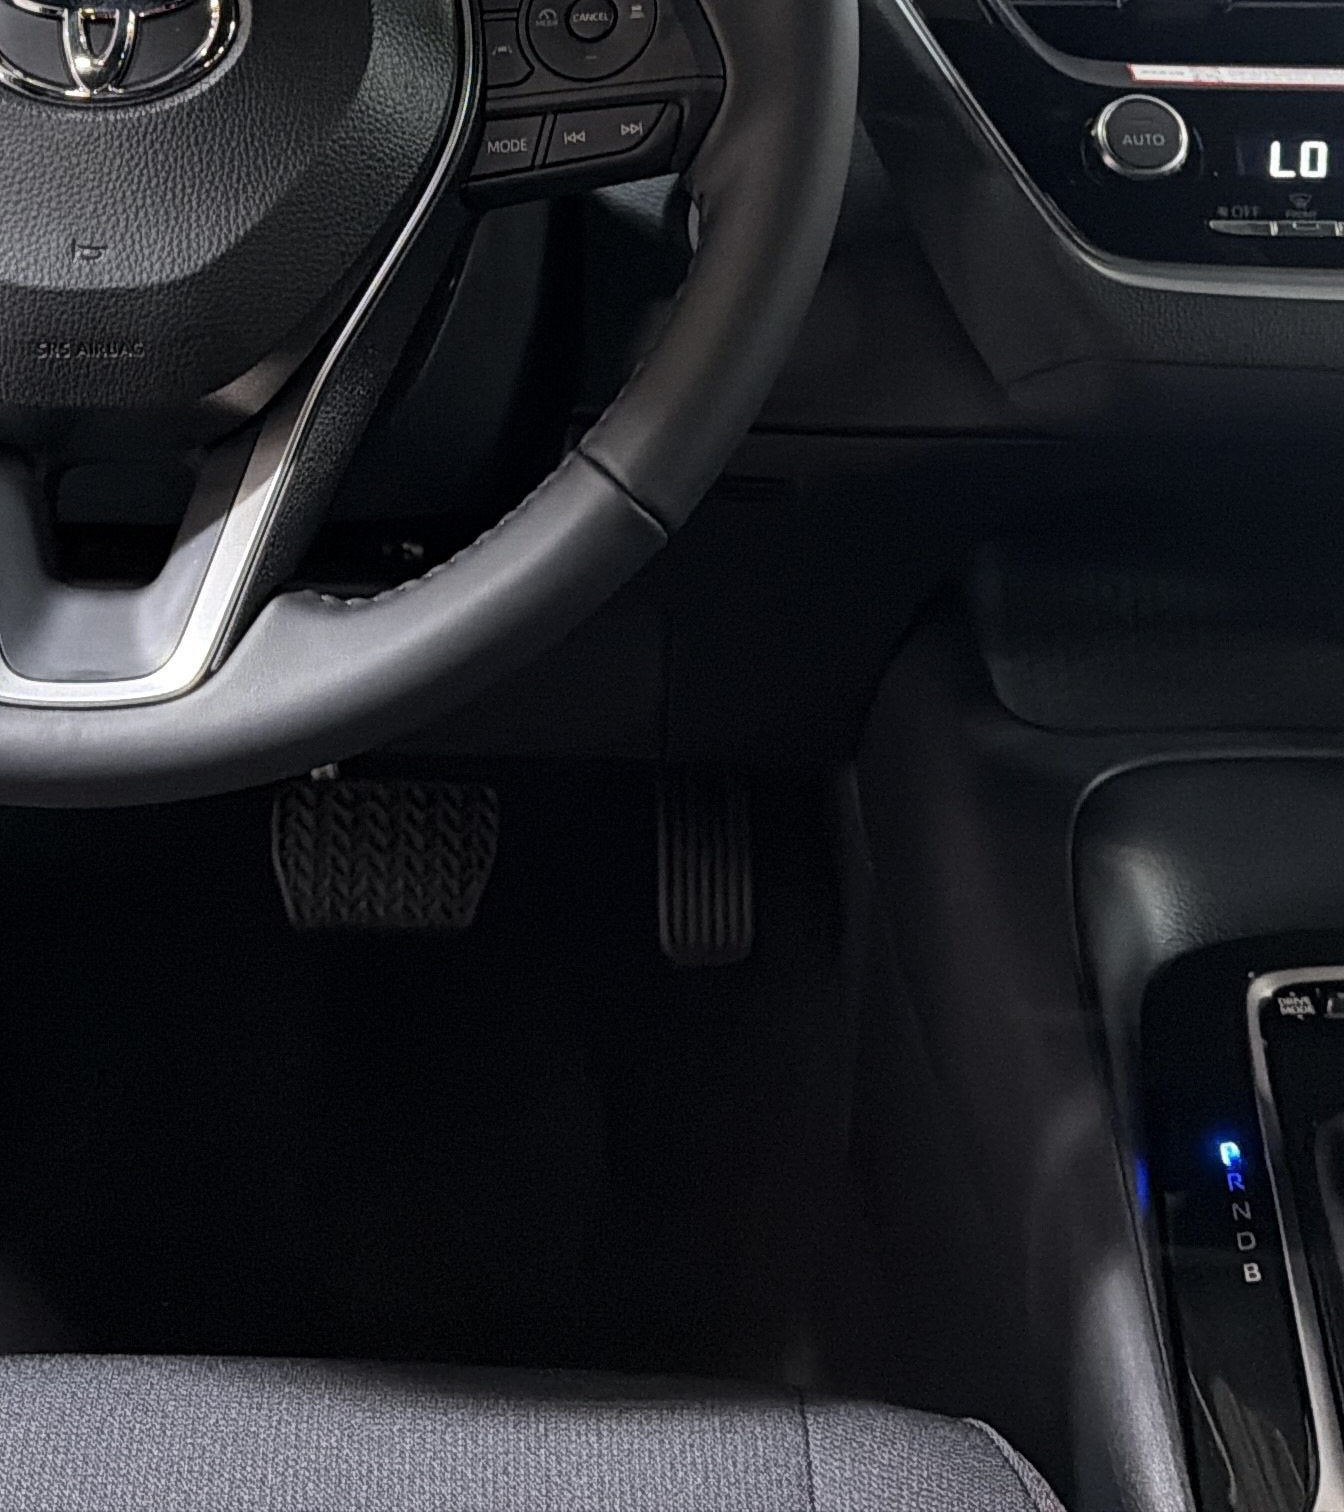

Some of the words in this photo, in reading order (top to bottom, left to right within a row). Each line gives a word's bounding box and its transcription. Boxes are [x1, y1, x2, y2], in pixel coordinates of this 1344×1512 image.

[572, 12, 609, 23] CANCEL
[487, 139, 528, 154] MODE
[1122, 131, 1165, 147] AUTO
[1269, 140, 1329, 180] LO
[1219, 1141, 1241, 1167] P
[1227, 1173, 1246, 1191] R
[1232, 1202, 1252, 1221] N
[1237, 1232, 1256, 1251] D
[1243, 1263, 1262, 1283] B
